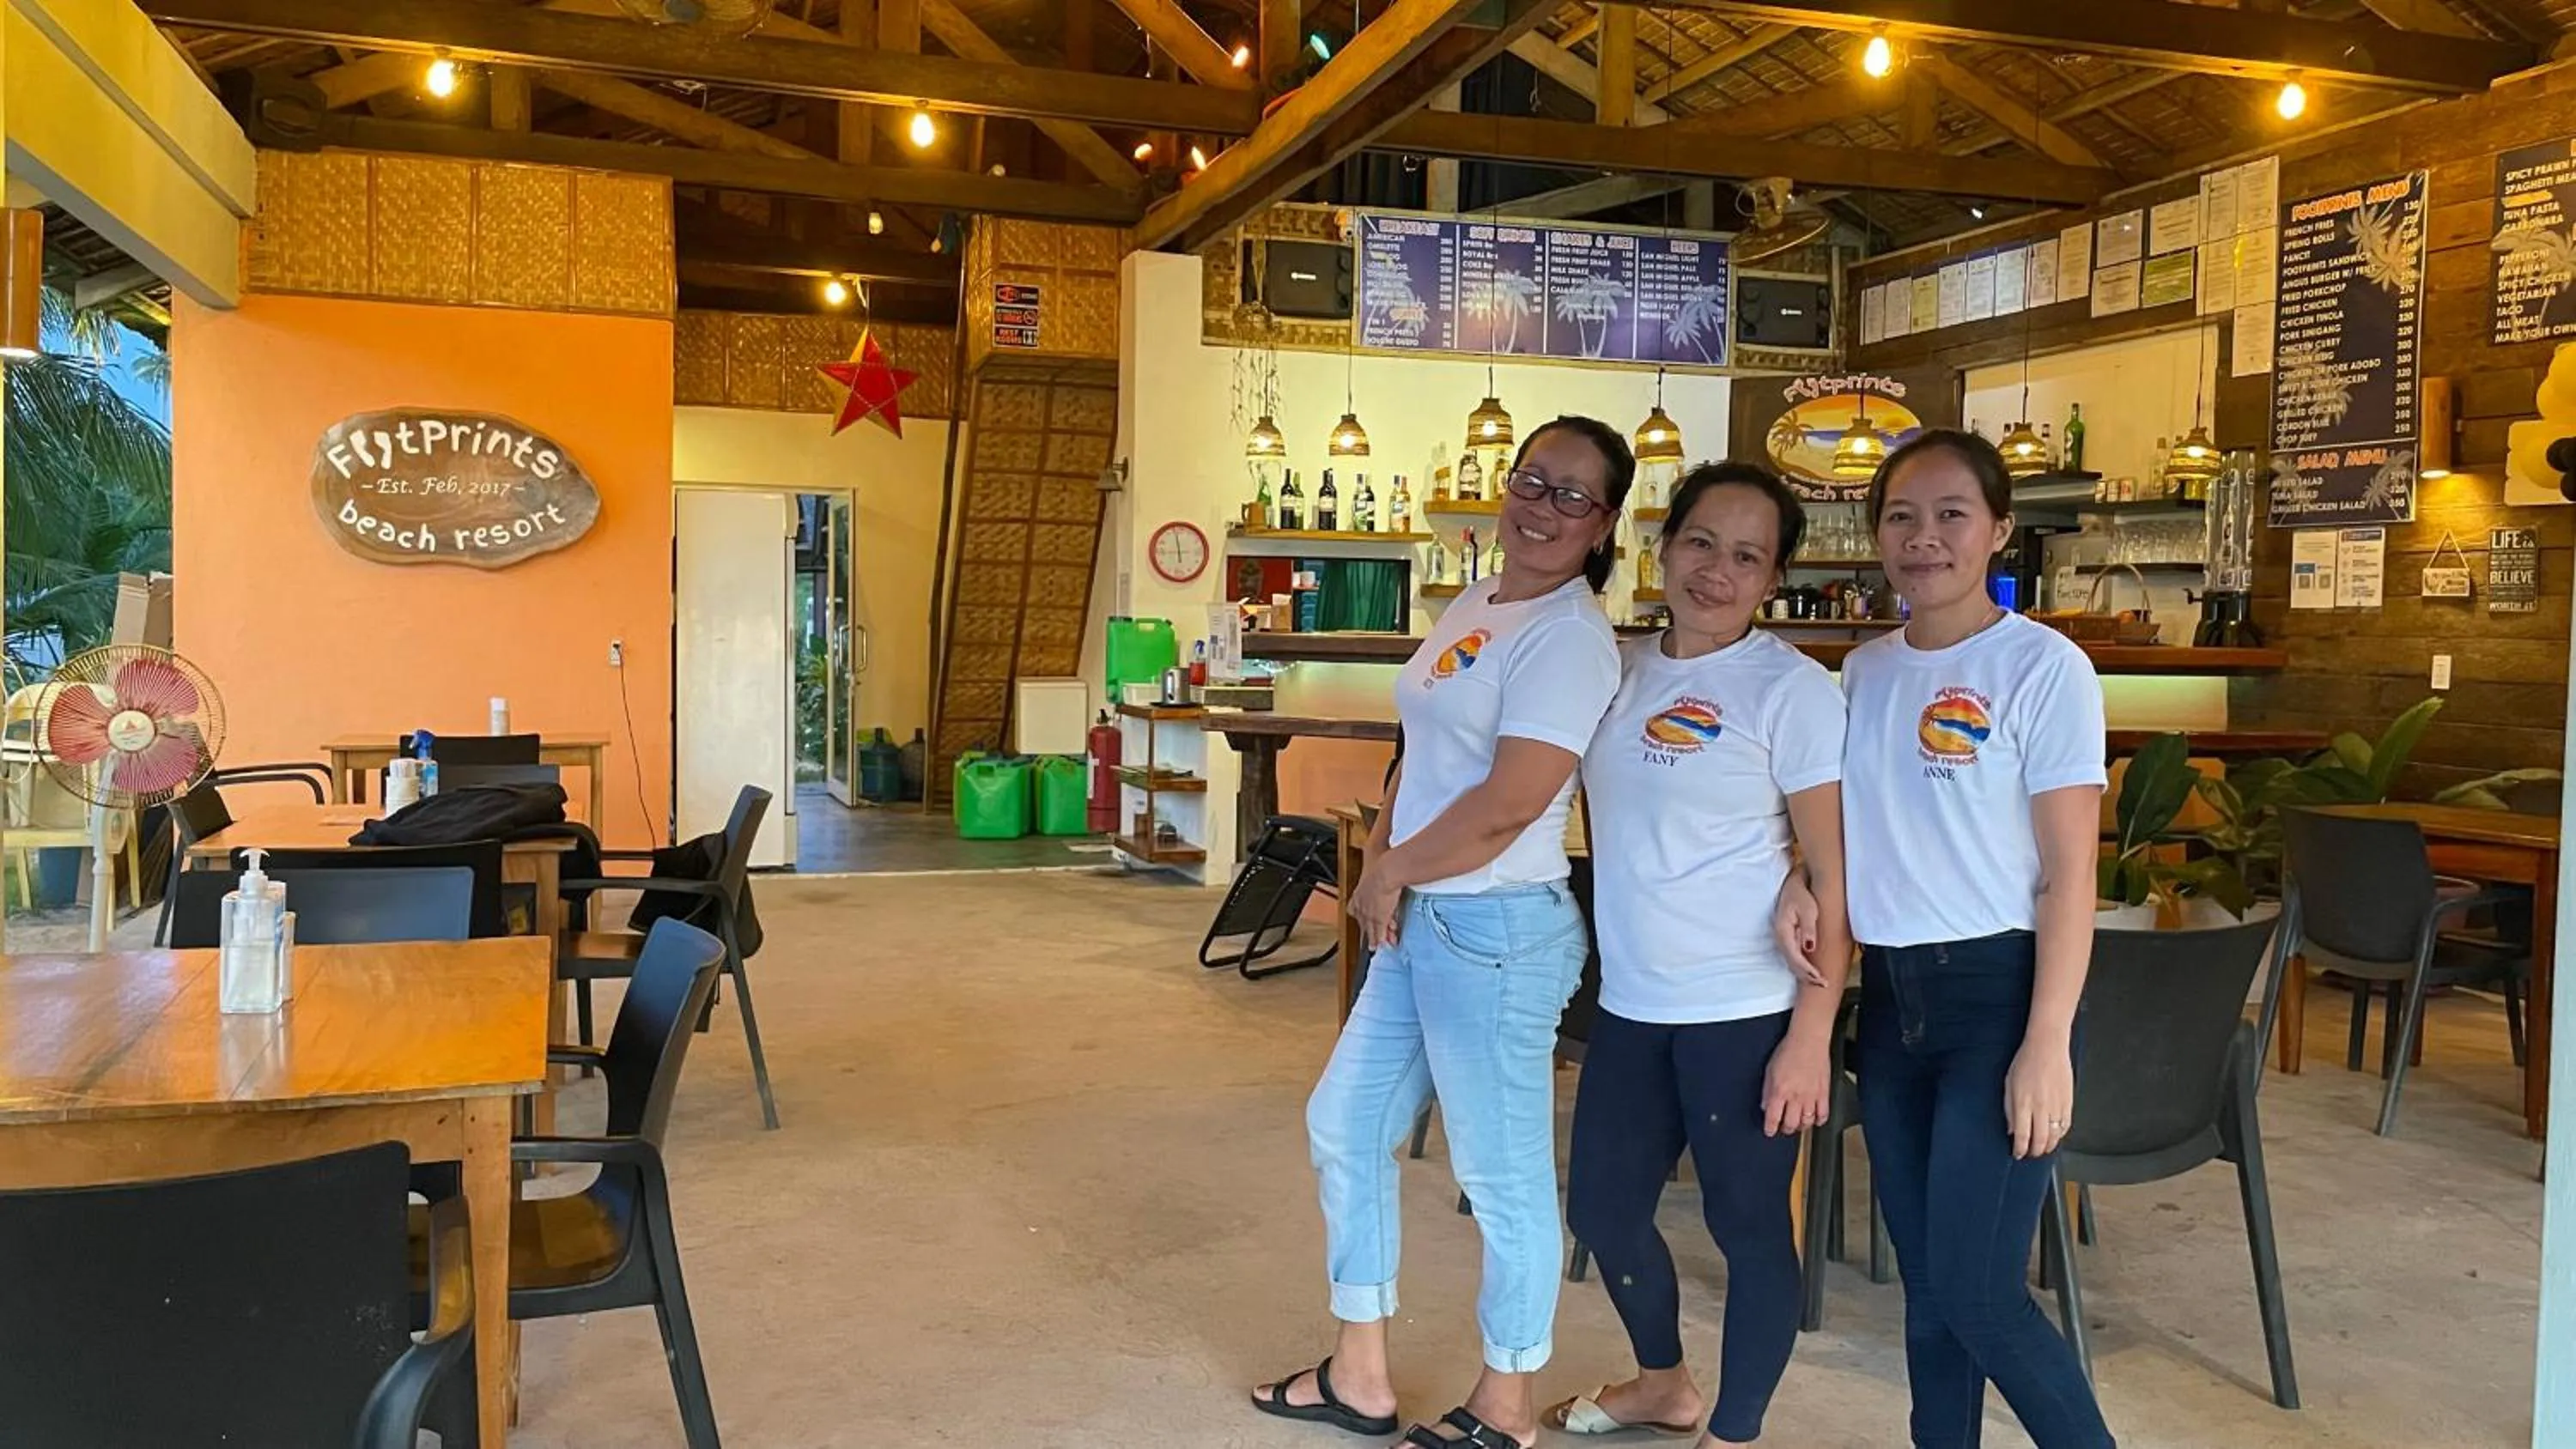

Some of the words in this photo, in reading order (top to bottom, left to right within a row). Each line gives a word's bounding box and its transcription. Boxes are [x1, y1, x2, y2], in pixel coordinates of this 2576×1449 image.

[2506, 168, 2534, 183] SPICY
[2534, 160, 2570, 176] PRAWN
[2506, 177, 2553, 195] SPAGHETTI
[2292, 190, 2362, 221] FOOTPRINTS
[2366, 179, 2410, 204] MENU
[2503, 208, 2528, 221] TUNA
[2530, 201, 2560, 215] PASTA
[2284, 224, 2313, 237] FRENCH
[2315, 219, 2334, 230] FRIES
[2283, 237, 2311, 251] SPRING
[2313, 232, 2335, 244] ROLLS
[2282, 261, 2326, 276] FOOTPRINTS
[2329, 252, 2372, 266] SANDWICH
[2499, 249, 2549, 264] PEPPERONI
[2282, 277, 2308, 289] ANGUS
[2311, 271, 2340, 284] BURGER
[2498, 279, 2525, 292] SPICY
[2528, 272, 2570, 286] CHICKEN
[2281, 291, 2301, 302] FRIED
[2303, 283, 2347, 299] PORKCHOP
[2497, 286, 2555, 303] VEGETARIAN
[2281, 305, 2300, 315] FRIED
[2303, 298, 2338, 312] CHICKEN
[2497, 305, 2524, 317] TACO
[2281, 315, 2314, 328] CHICKEN
[2317, 310, 2344, 322] TINOLA
[2496, 318, 2511, 330] ALL
[2513, 315, 2539, 327] MEAT
[2281, 332, 2300, 342] PORK
[2302, 324, 2342, 337] SINIGANG
[2495, 330, 2522, 343] MAKE
[2524, 327, 2550, 338] YOUR
[2280, 341, 2313, 354] CHICKEN
[2315, 337, 2341, 348] CURRY
[2279, 355, 2312, 367] CHICKEN
[2279, 367, 2312, 380] CHICKEN
[2329, 362, 2348, 373] PORK
[2351, 358, 2380, 370] ADOBO
[2331, 373, 2369, 386] CHICKEN
[2277, 395, 2312, 406] CHICKEN
[2308, 402, 2345, 415] CHICKEN
[2277, 421, 2310, 432] CORDON
[2276, 435, 2297, 445] CHOP
[2297, 452, 2339, 469] SALAD
[2344, 448, 2388, 466] MENU
[377, 478, 414, 494] Est.
[469, 482, 512, 495] 2017
[2299, 476, 2323, 486] SALAD
[2303, 501, 2338, 512] CHICKEN
[2340, 500, 2366, 510] SALAD
[338, 499, 436, 552] beach
[454, 502, 567, 550] resort
[2492, 530, 2521, 548] LIFE
[2490, 570, 2534, 585] BELIEVE
[1643, 750, 1680, 767] FANY
[1923, 766, 1955, 781] ANNE
